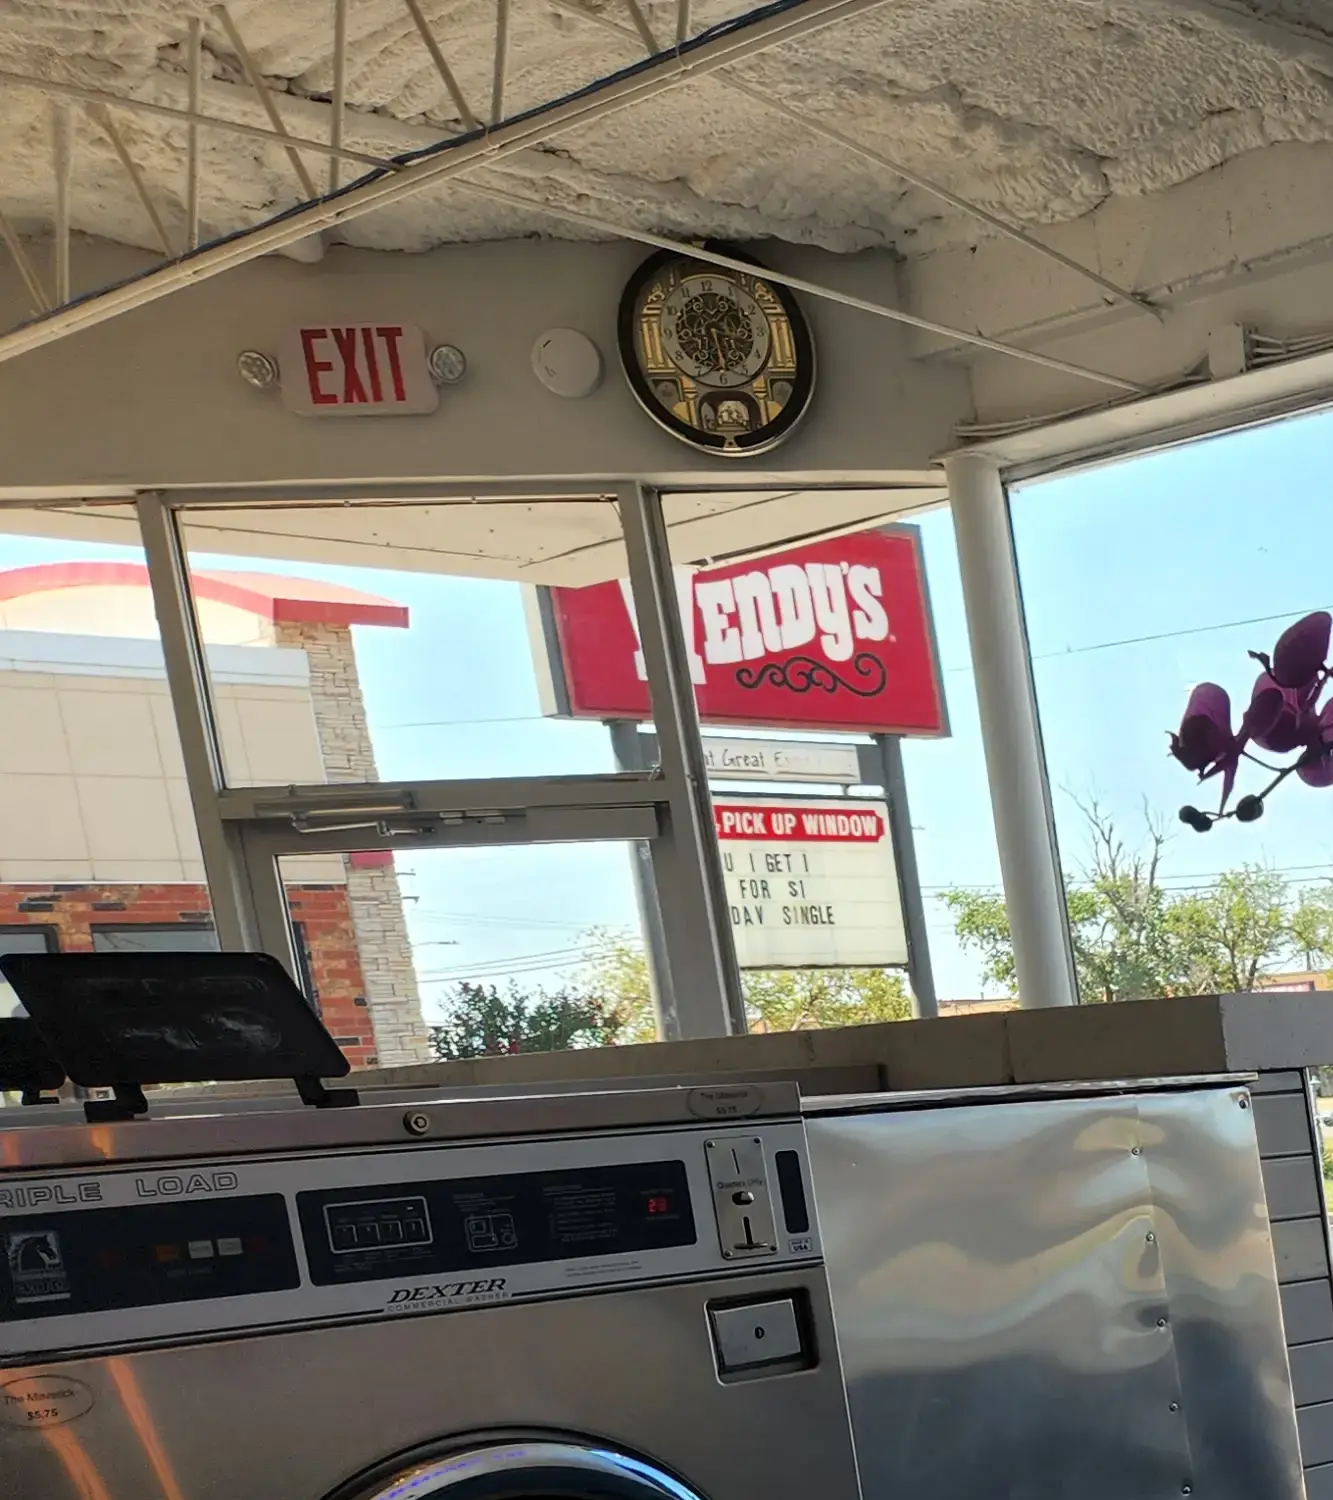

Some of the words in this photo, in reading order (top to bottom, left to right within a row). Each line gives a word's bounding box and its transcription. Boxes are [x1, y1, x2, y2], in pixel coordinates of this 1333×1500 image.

[300, 327, 406, 404] EXIT
[722, 749, 764, 767] Great
[722, 812, 766, 834] PICK
[772, 813, 796, 835] UP
[803, 814, 876, 836] WINDOW
[765, 854, 791, 873] GET
[740, 879, 771, 899] FOR
[783, 906, 836, 925] SINGLE
[135, 1171, 239, 1198] LOAD
[387, 1278, 506, 1304] DEXTER
[387, 1299, 459, 1312] COMMERCIAL
